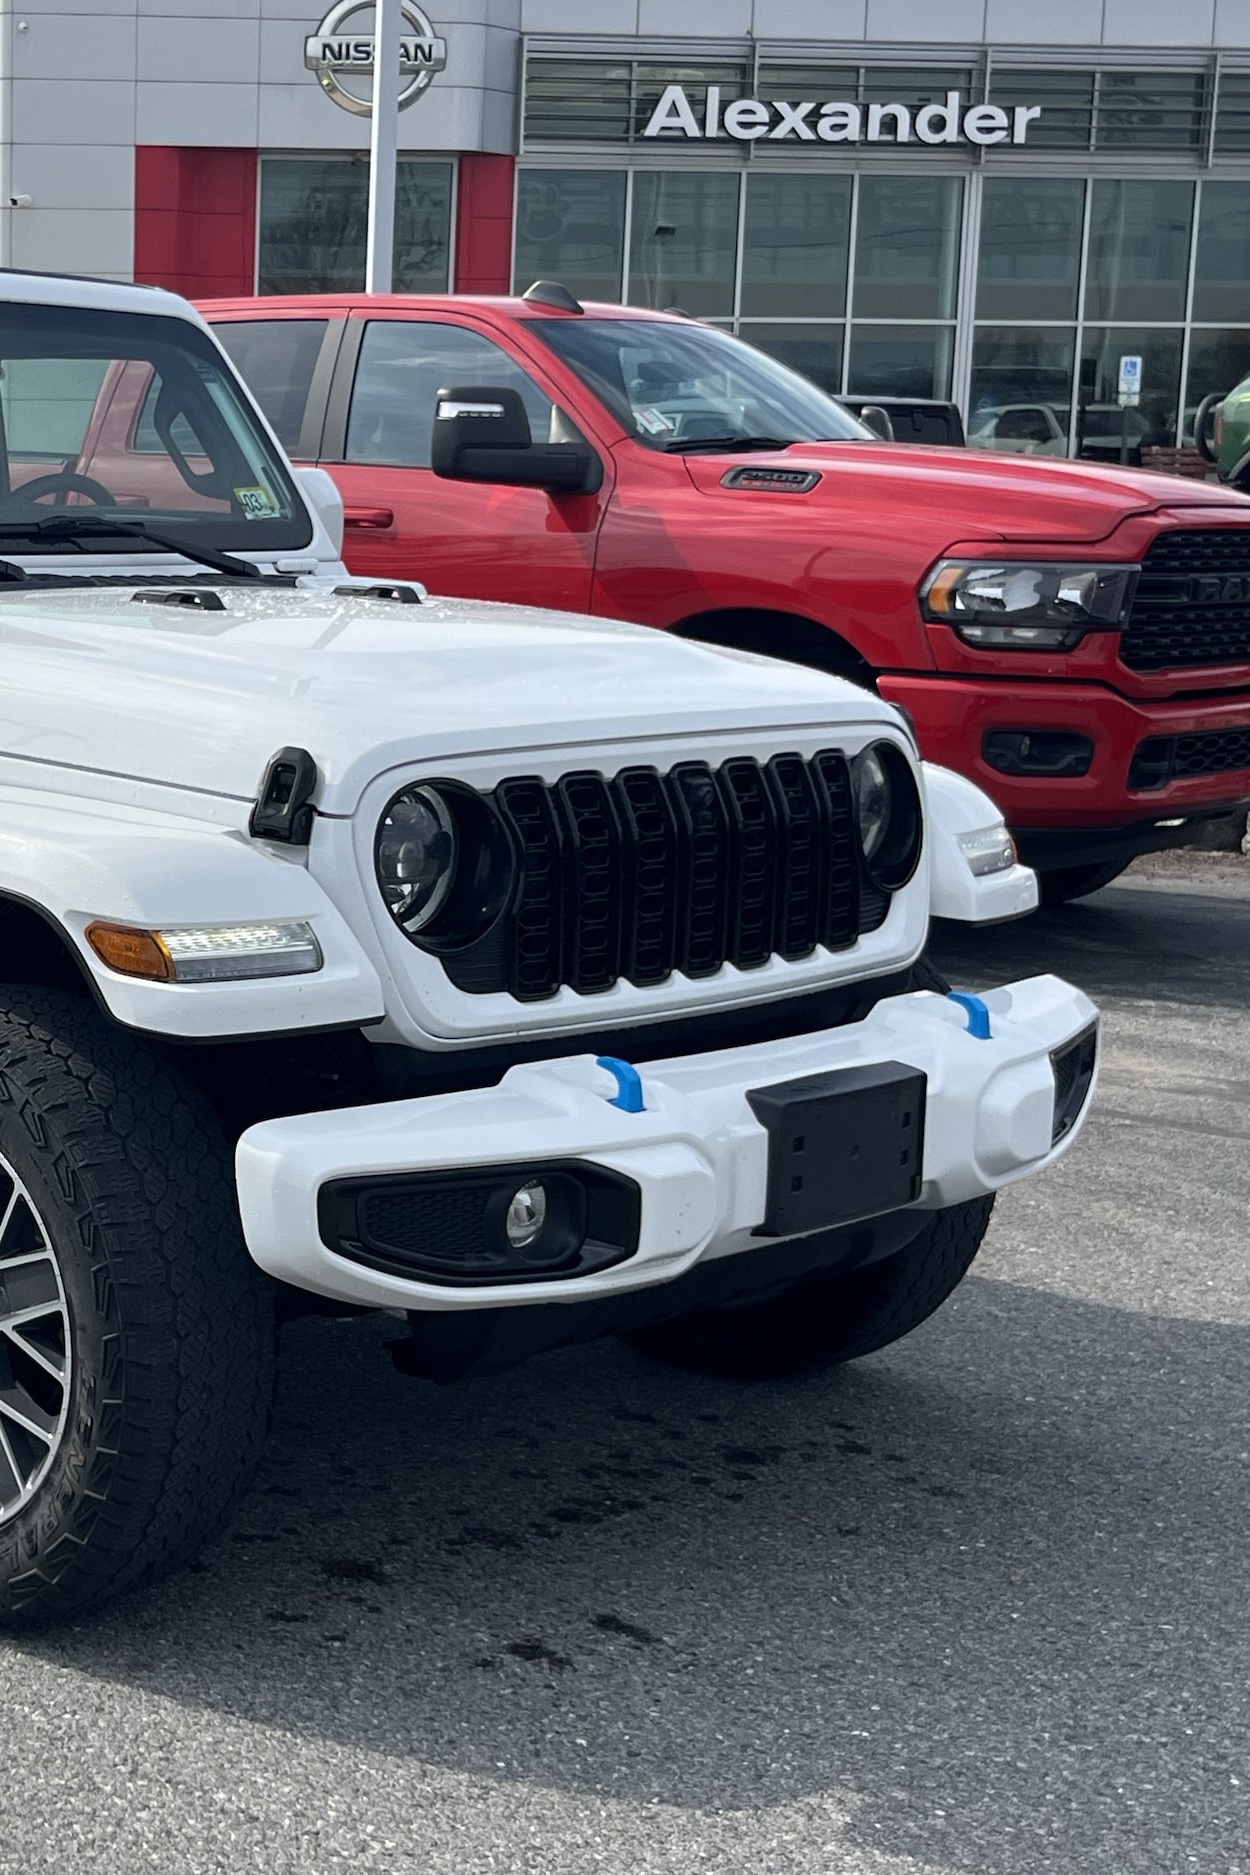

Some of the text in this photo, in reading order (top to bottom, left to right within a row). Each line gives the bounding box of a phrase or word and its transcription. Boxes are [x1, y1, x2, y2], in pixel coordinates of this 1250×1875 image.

[321, 42, 434, 63] NISAN
[643, 84, 1042, 147] Alexander
[243, 493, 264, 513] 03
[1197, 576, 1250, 602] RA
